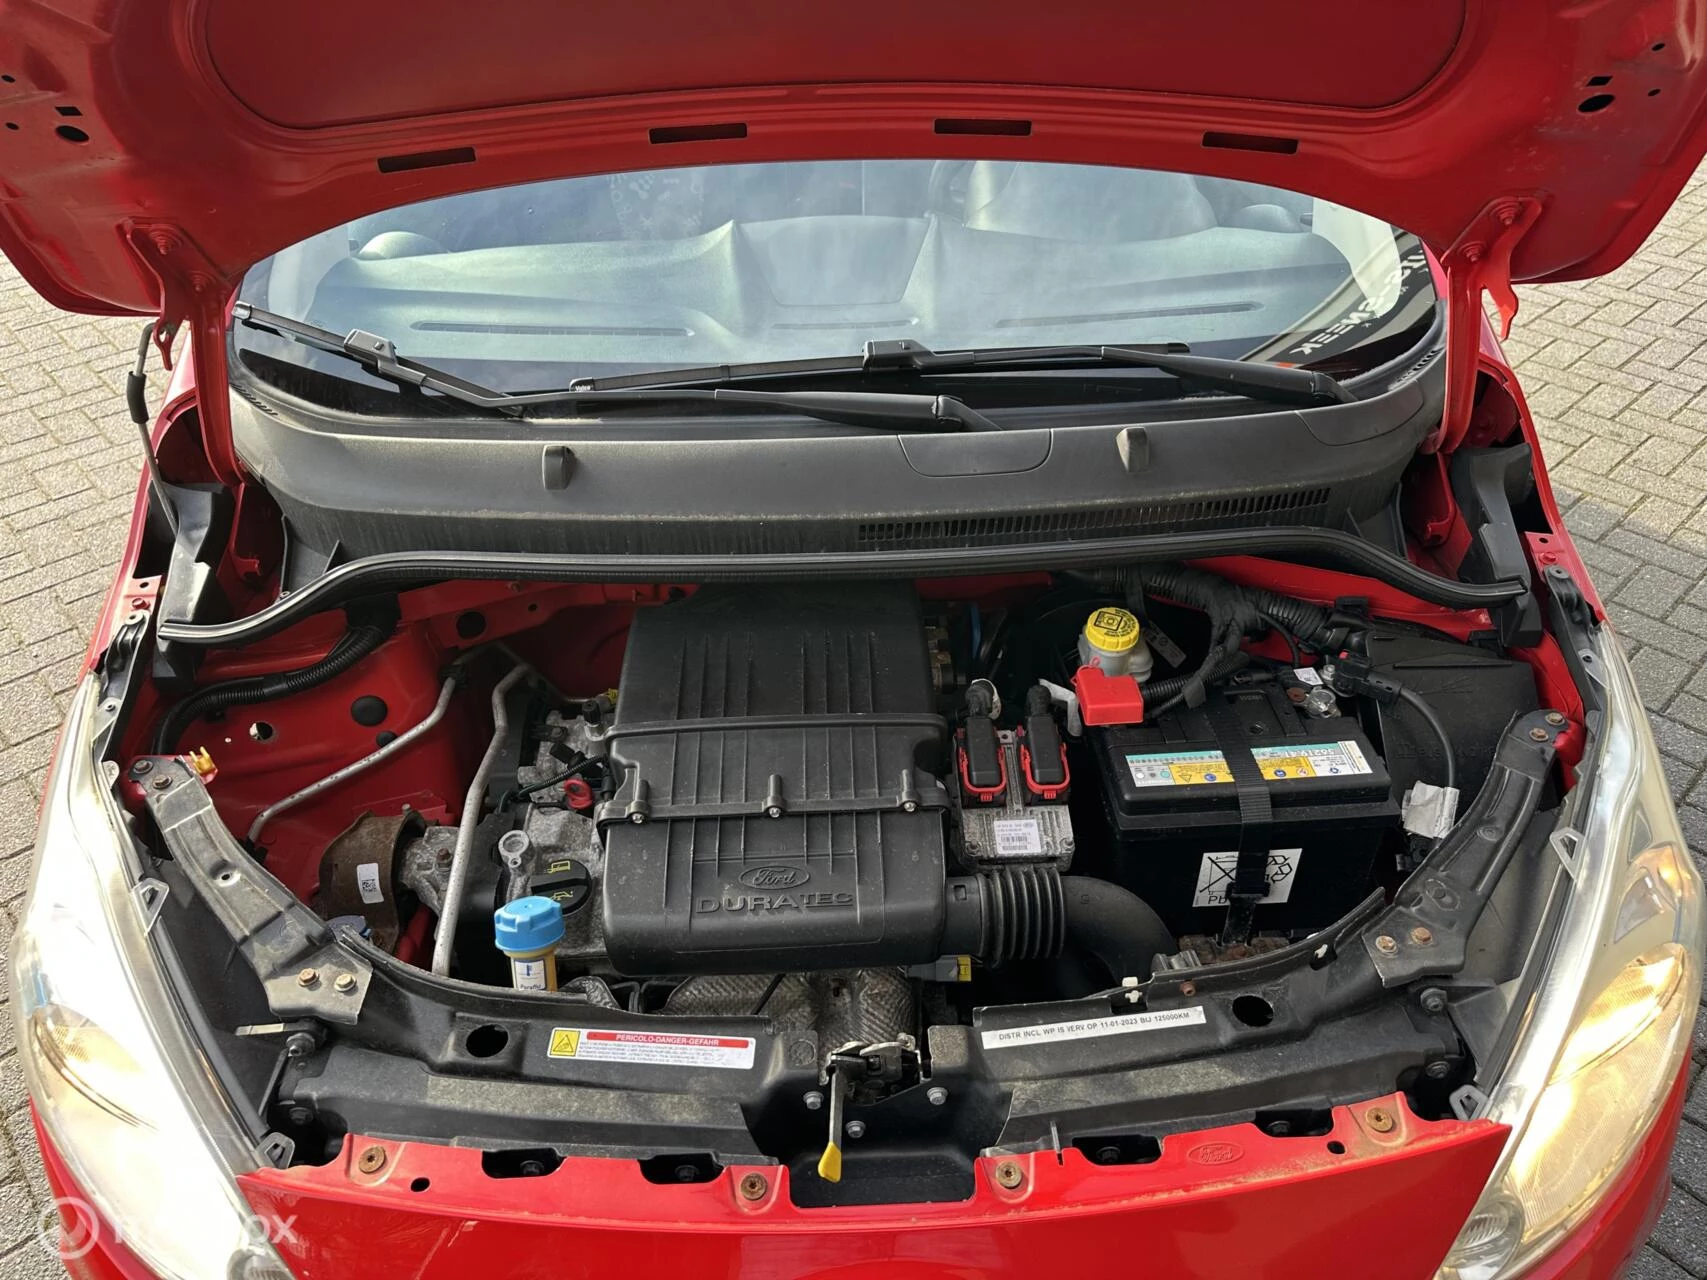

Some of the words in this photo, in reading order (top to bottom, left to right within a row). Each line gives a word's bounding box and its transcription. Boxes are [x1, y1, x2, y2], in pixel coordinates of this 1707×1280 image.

[752, 868, 797, 886] Ford
[696, 892, 854, 914] DURATEC
[1208, 895, 1228, 904] Pb
[999, 1030, 1022, 1041] DISTR
[1023, 1028, 1042, 1038] INCL
[1043, 1027, 1056, 1036] WP
[1057, 1026, 1065, 1034] IS
[1087, 1022, 1098, 1031] OP
[1100, 1017, 1139, 1029] 11-01-2023
[1154, 1011, 1190, 1023] 125000KM
[616, 1033, 720, 1047] PERICOLO-DANGER-GEFAHR
